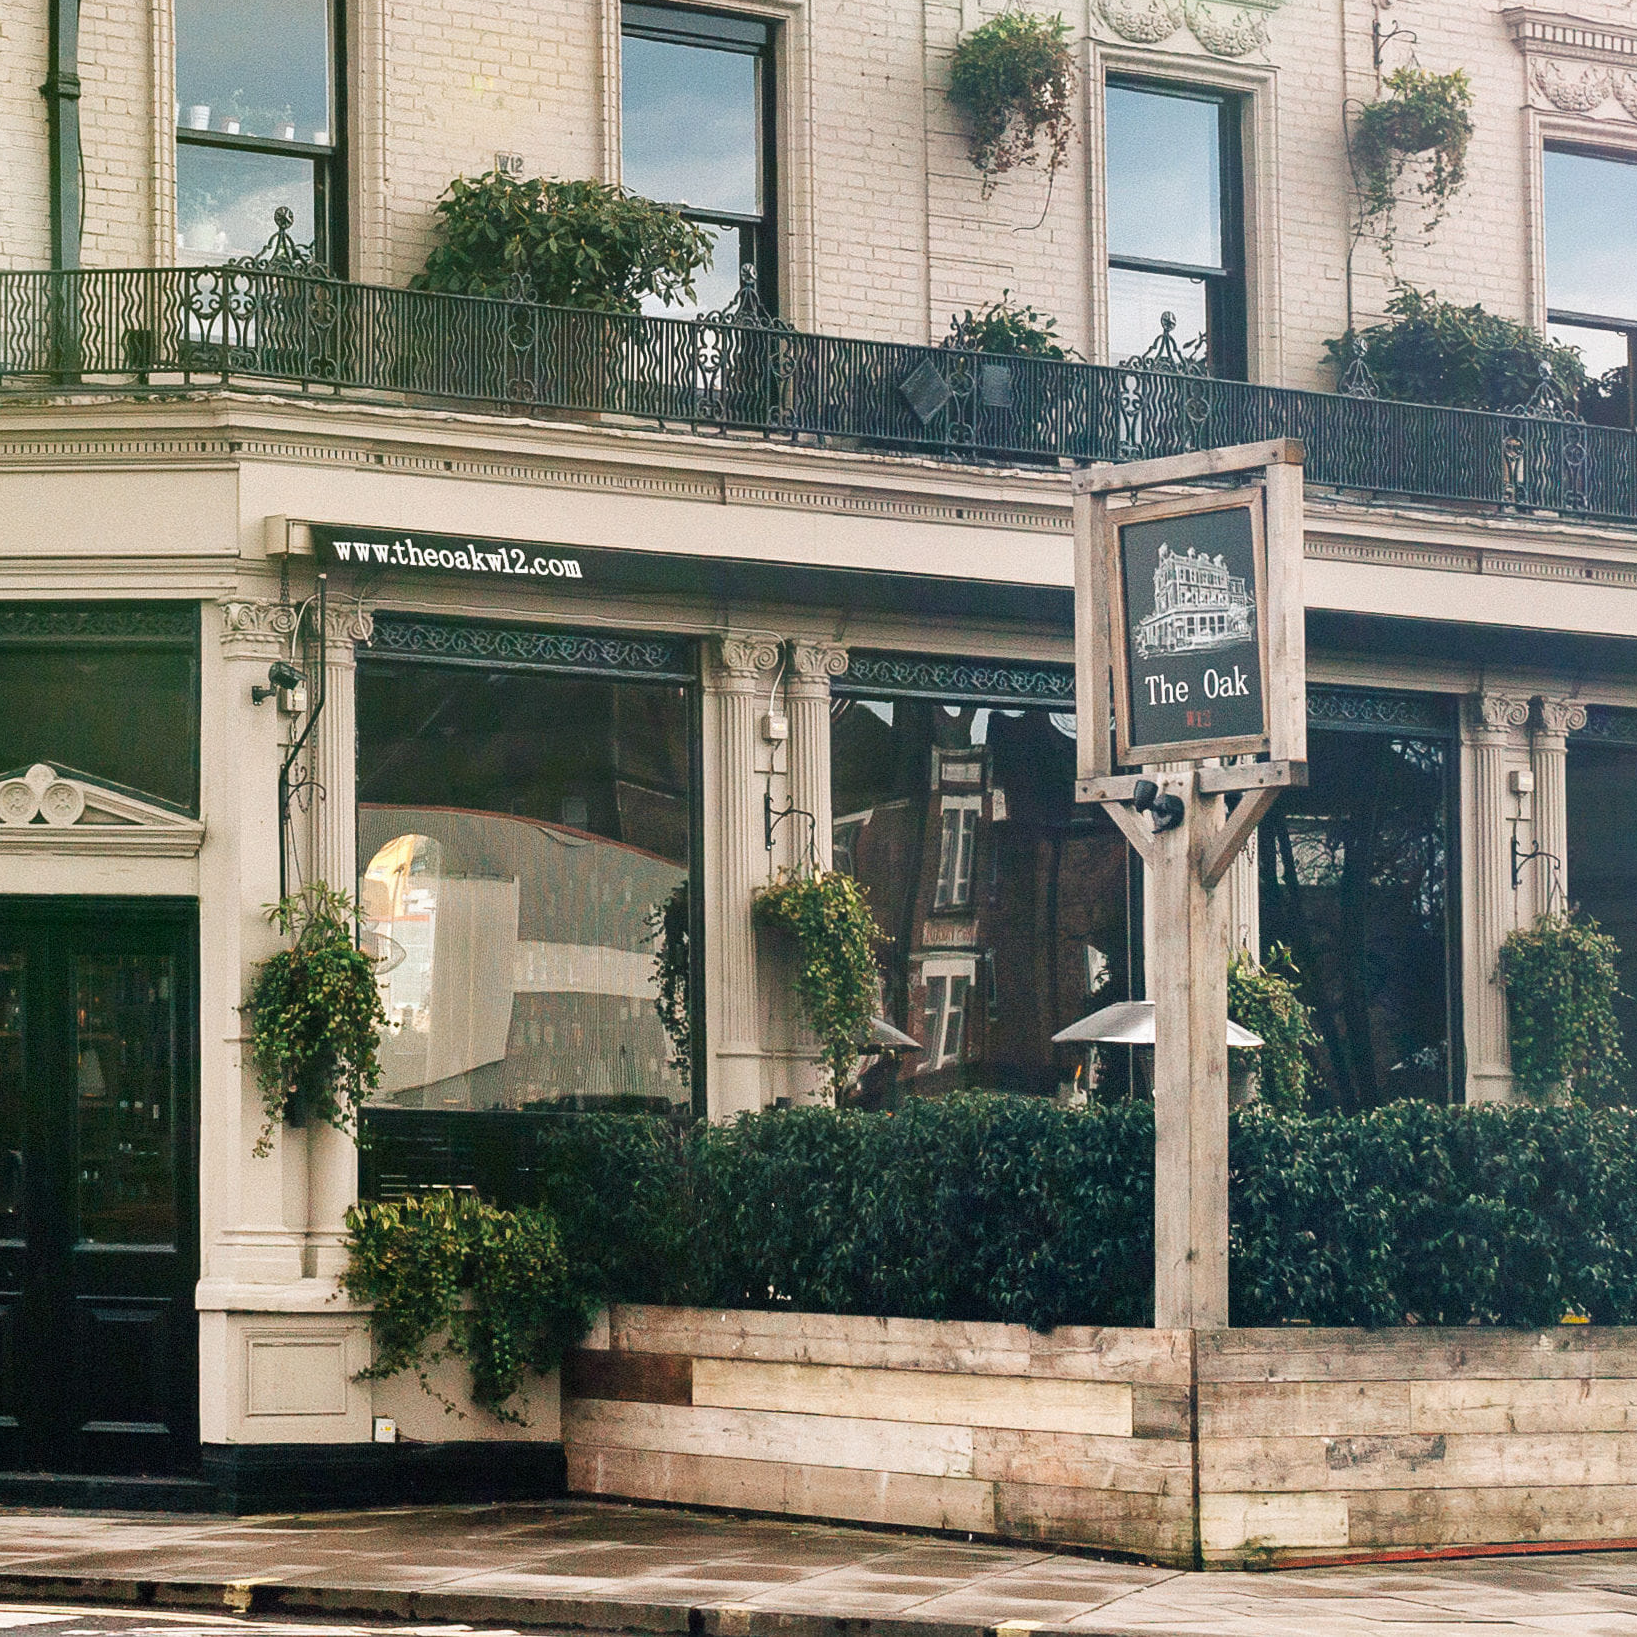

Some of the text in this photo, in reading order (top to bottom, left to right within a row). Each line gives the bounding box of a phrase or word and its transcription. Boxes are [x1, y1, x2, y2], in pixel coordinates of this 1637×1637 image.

[332, 538, 583, 579] www.theoakw12.com
[1144, 665, 1250, 706] The Oak
[1186, 710, 1212, 728] W12
